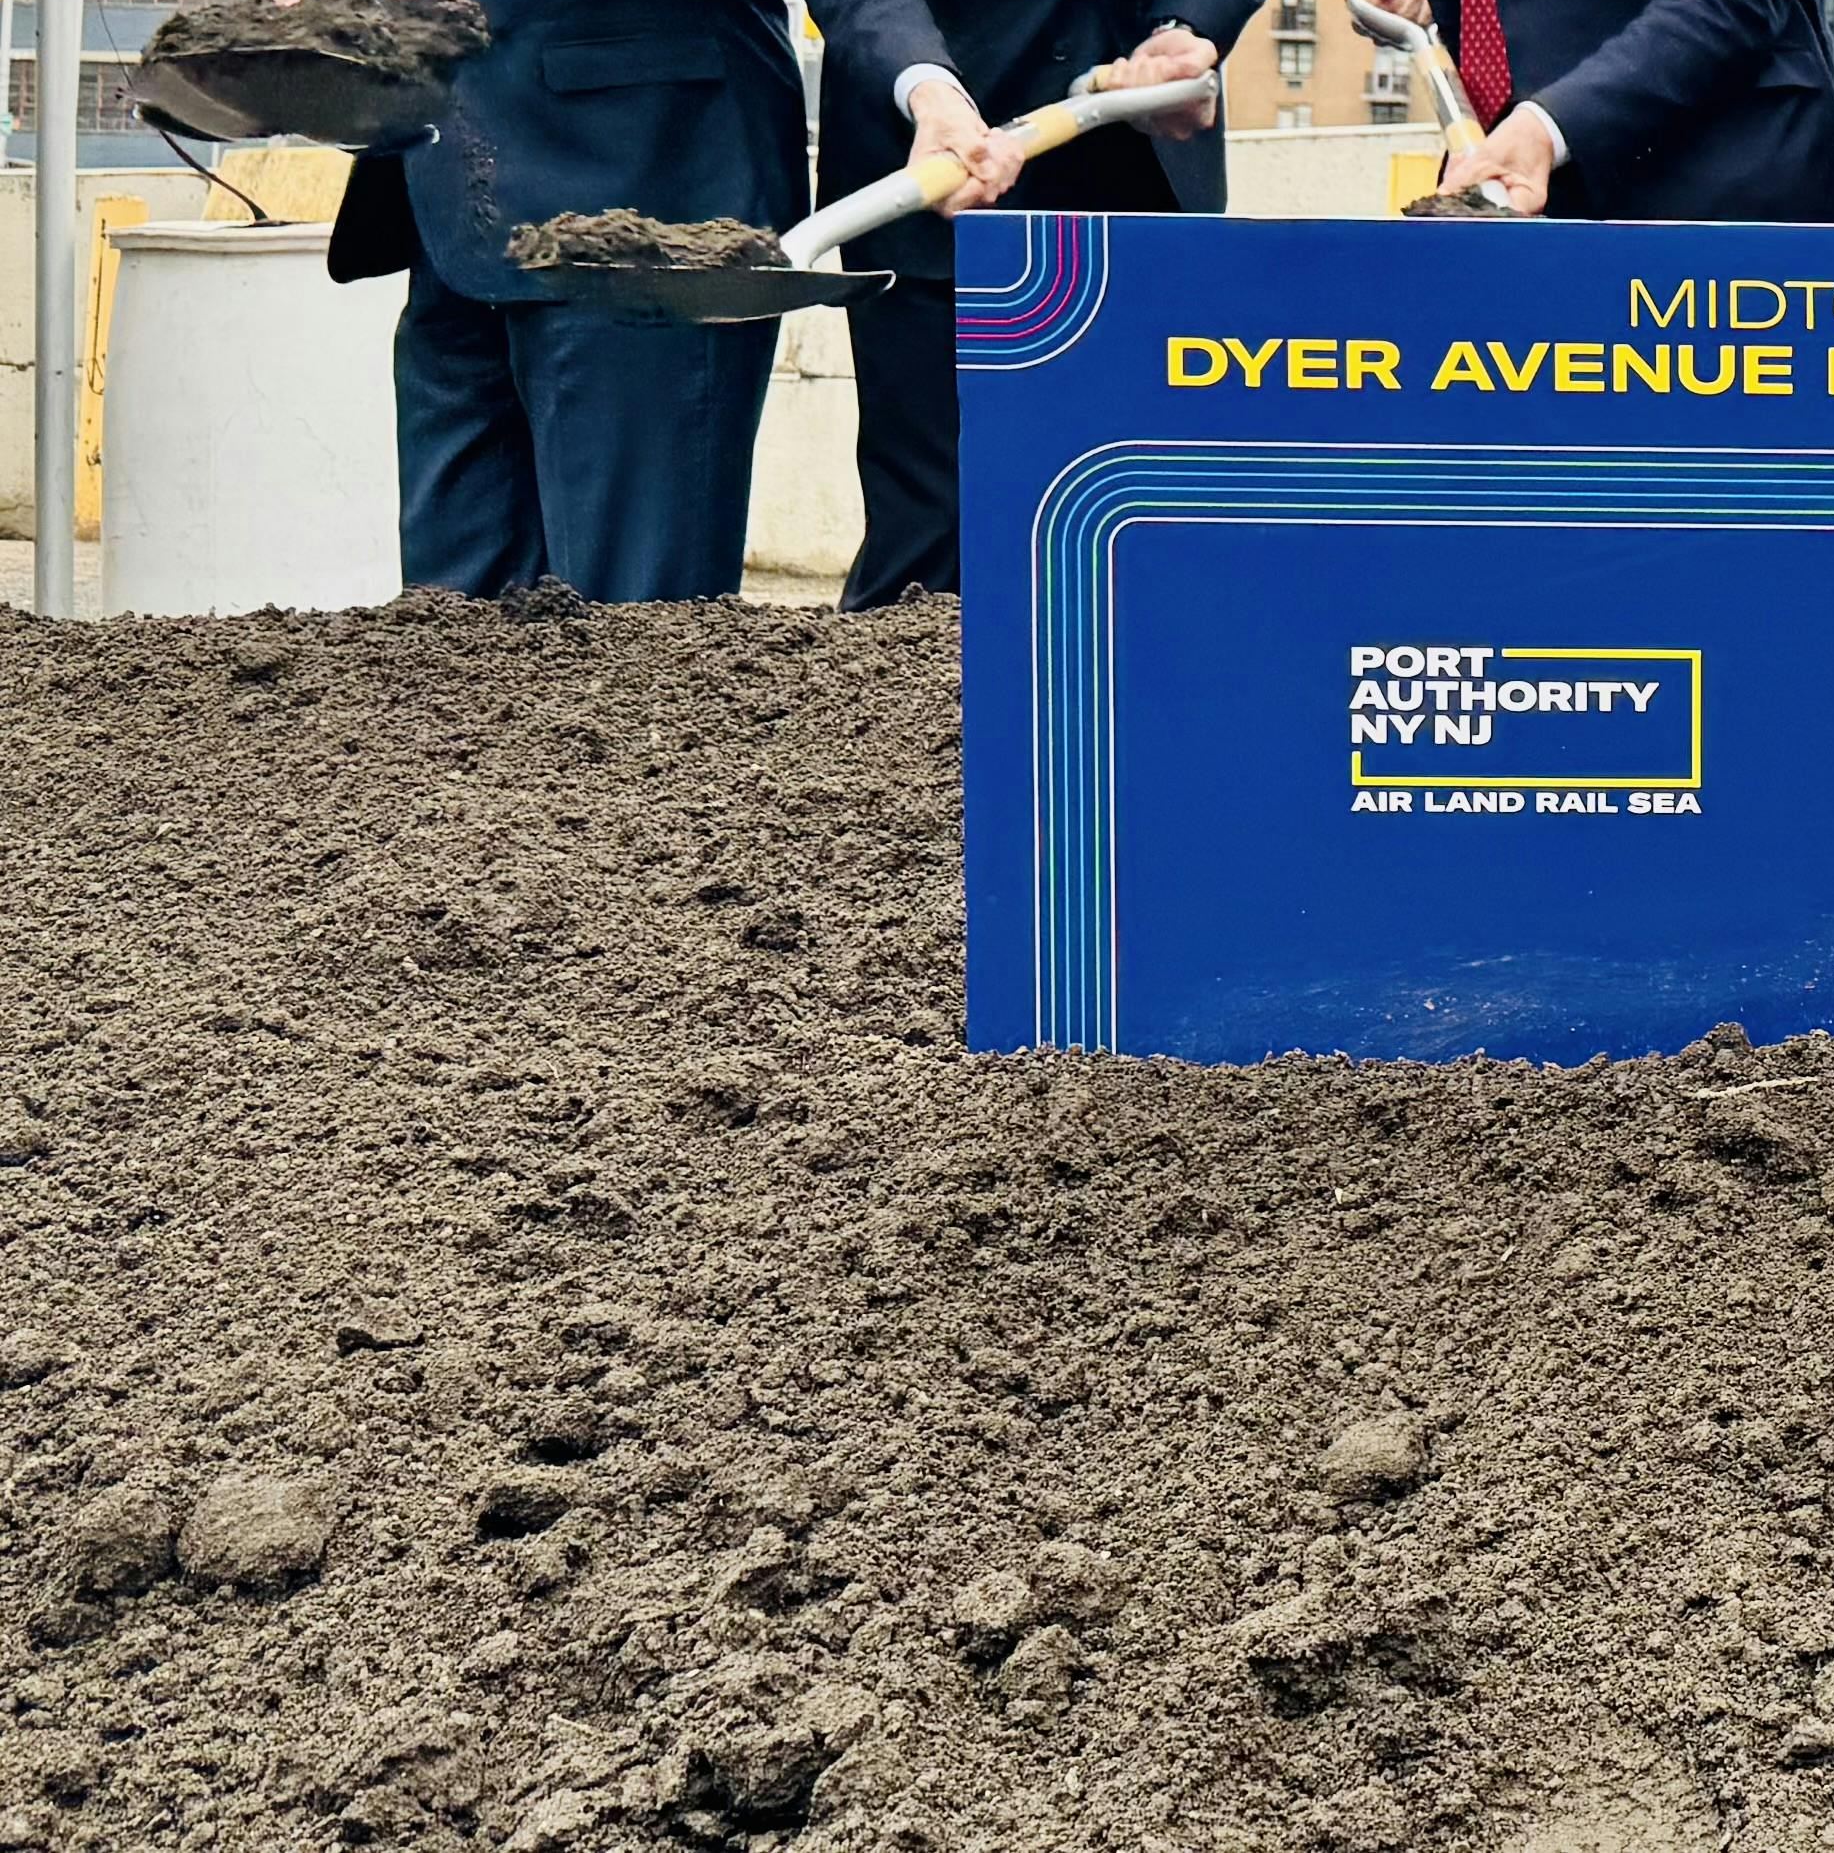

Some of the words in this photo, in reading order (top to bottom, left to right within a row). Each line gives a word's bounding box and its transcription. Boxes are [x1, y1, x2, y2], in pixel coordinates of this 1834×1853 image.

[1167, 336, 1402, 390] DYER
[1430, 341, 1794, 396] AVENUE
[1350, 646, 1494, 678] PORT
[1349, 680, 1660, 712] AUTHORITY
[1351, 714, 1426, 744] NY
[1434, 714, 1492, 745] NJ
[1350, 791, 1413, 813] AIR
[1424, 792, 1525, 813] LAND
[1535, 792, 1619, 814] RAIL
[1627, 792, 1702, 814] SEA
